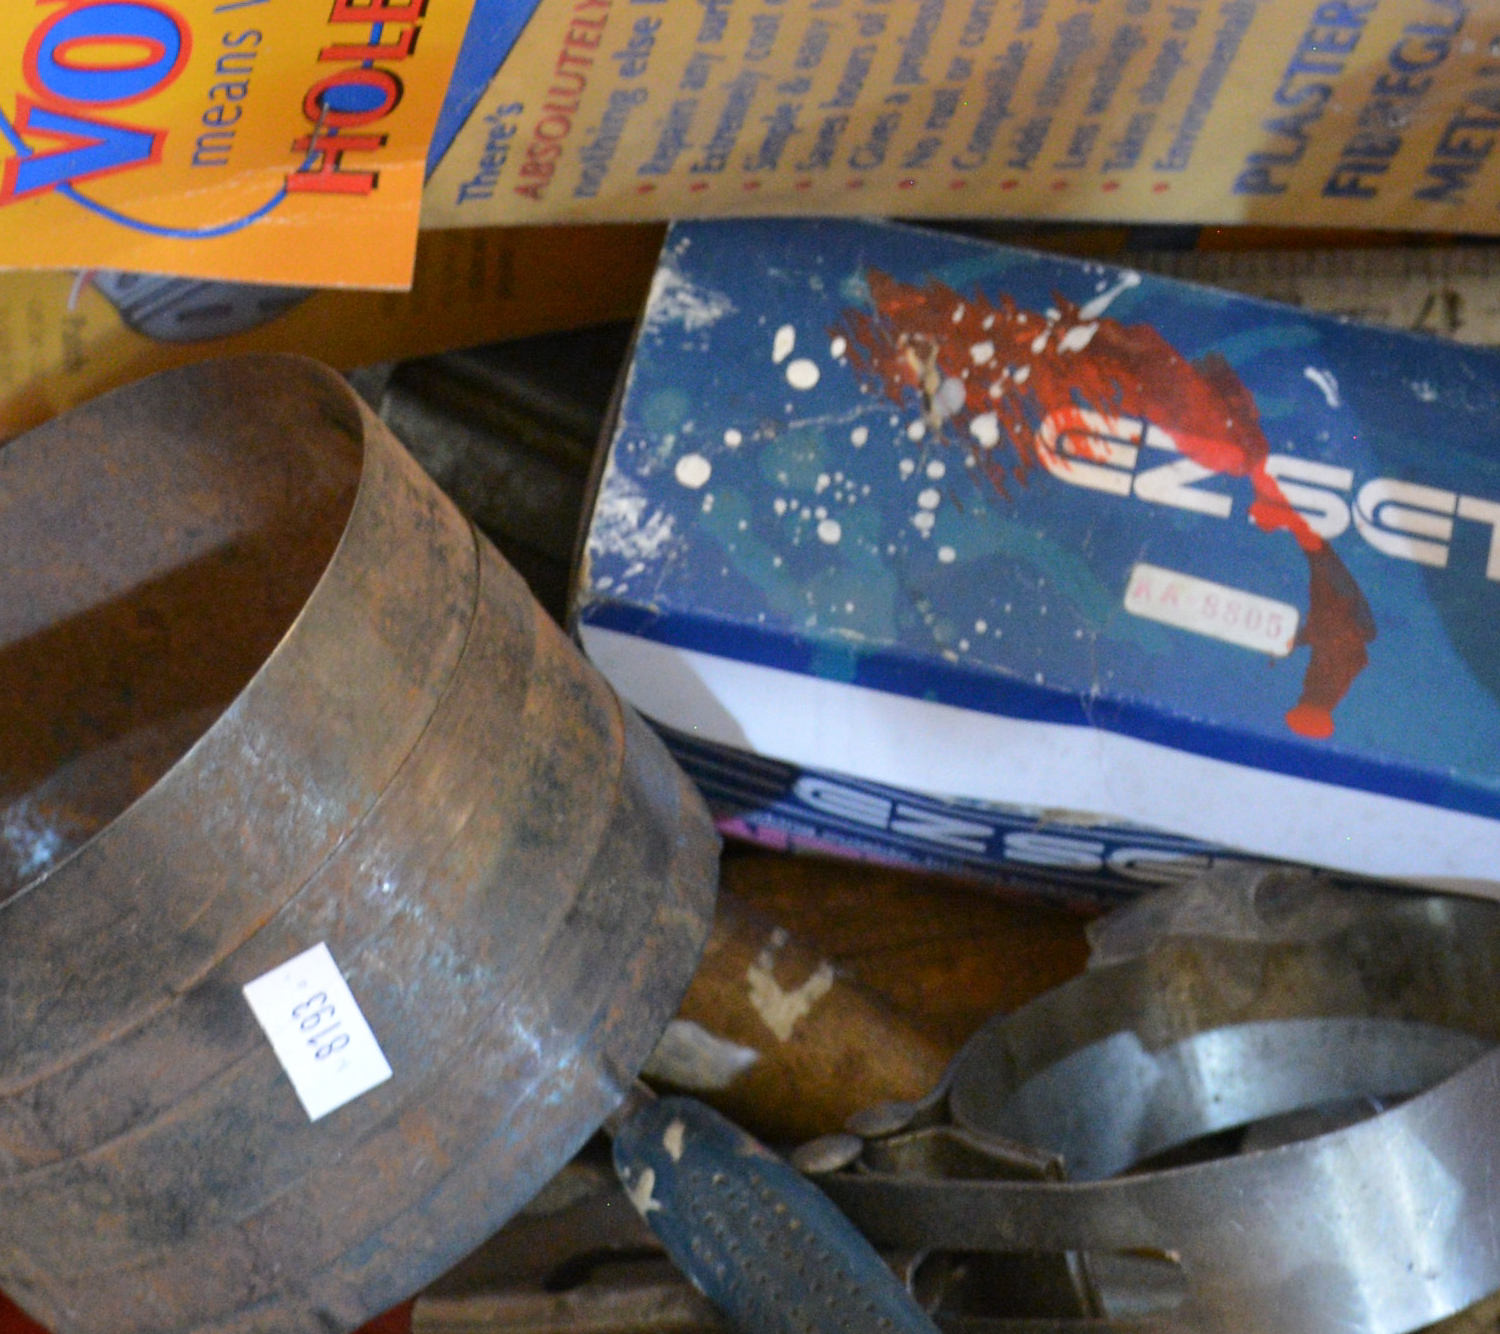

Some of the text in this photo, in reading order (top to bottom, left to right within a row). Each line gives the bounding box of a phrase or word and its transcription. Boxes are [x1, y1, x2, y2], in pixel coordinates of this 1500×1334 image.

[191, 28, 264, 169] means
[456, 100, 524, 205] There's
[573, 85, 650, 199] nothing
[612, 15, 662, 80] else
[291, 991, 351, 1061] 8193
